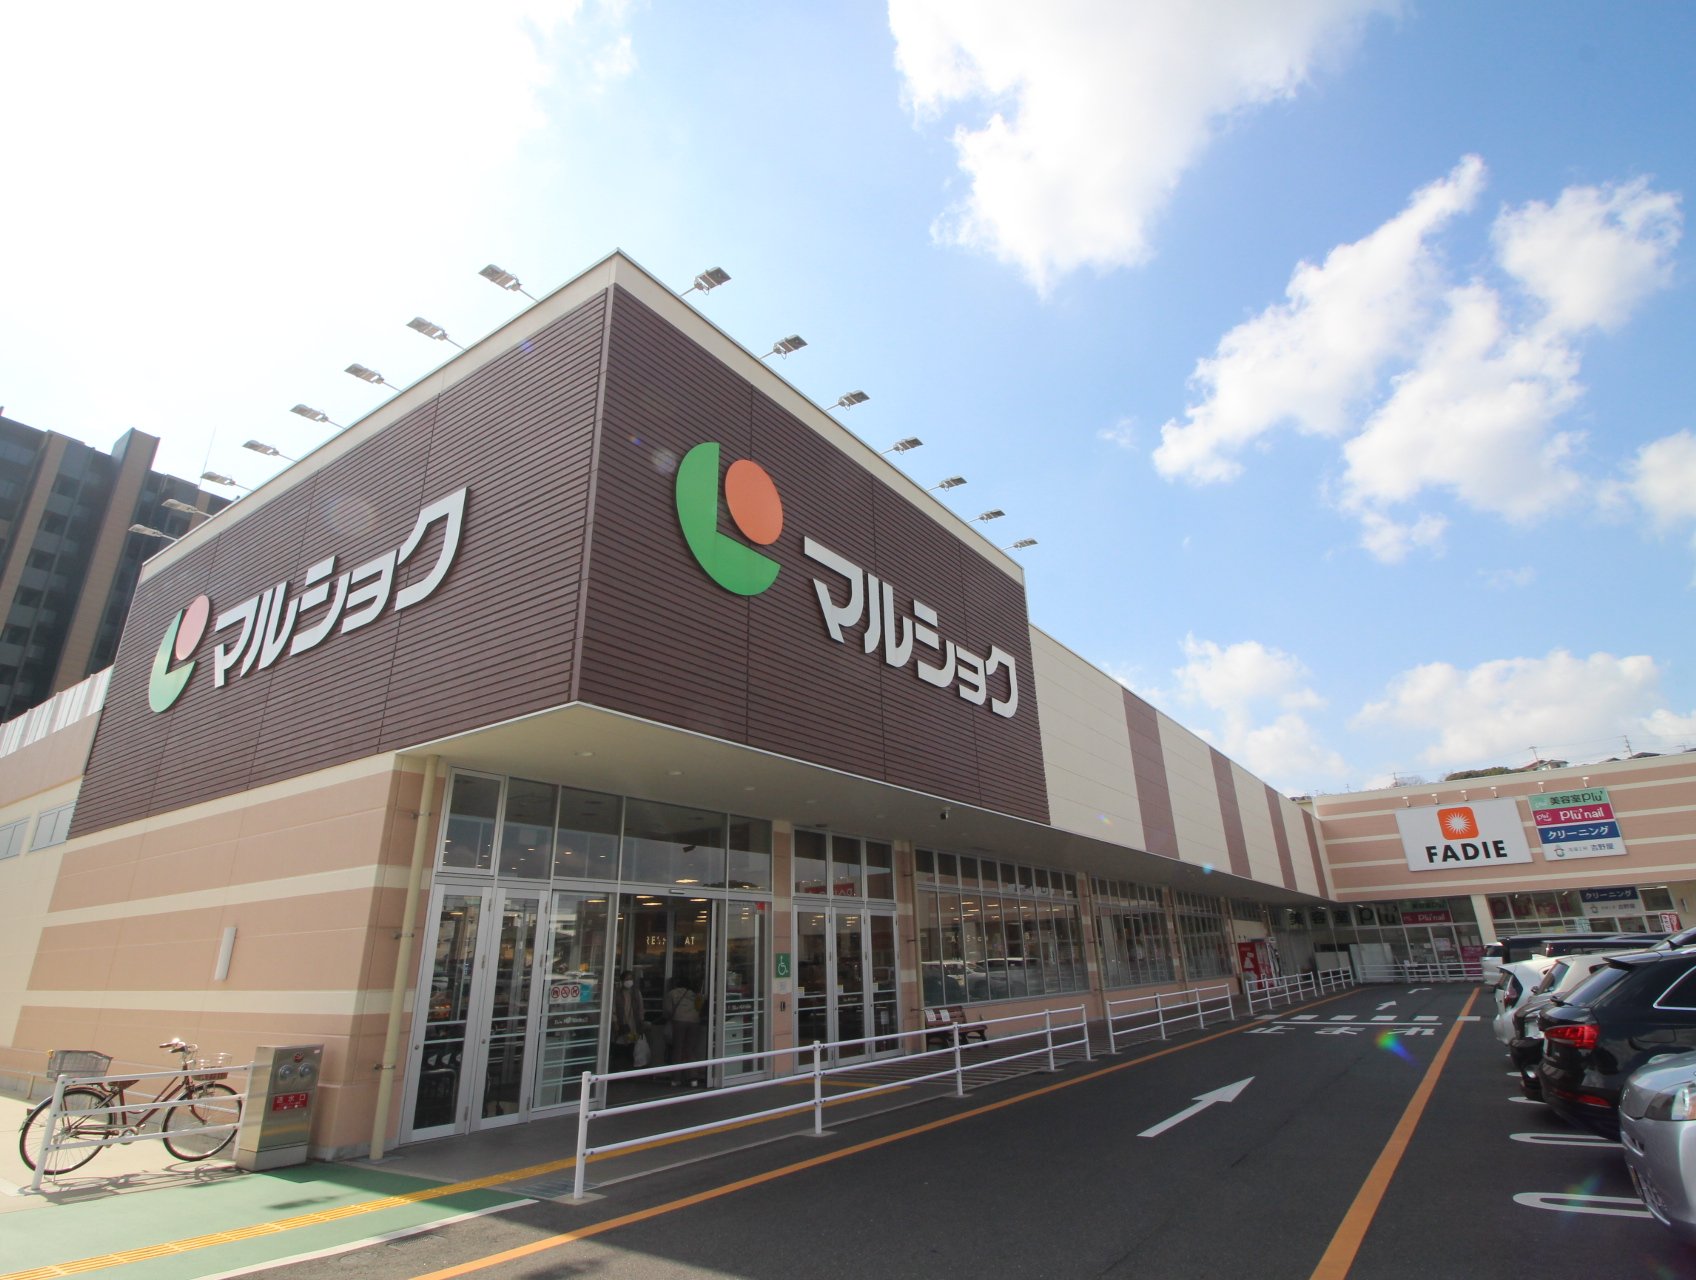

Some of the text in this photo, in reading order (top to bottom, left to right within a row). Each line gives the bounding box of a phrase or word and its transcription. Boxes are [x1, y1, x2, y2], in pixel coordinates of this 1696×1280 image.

[214, 486, 467, 688] マルショク
[804, 535, 1019, 718] マルショク
[1548, 825, 1609, 840] クリーニング
[1425, 840, 1508, 863] FADIE
[1585, 889, 1632, 900] クリーニング
[1243, 1025, 1436, 1037] 止まれ
